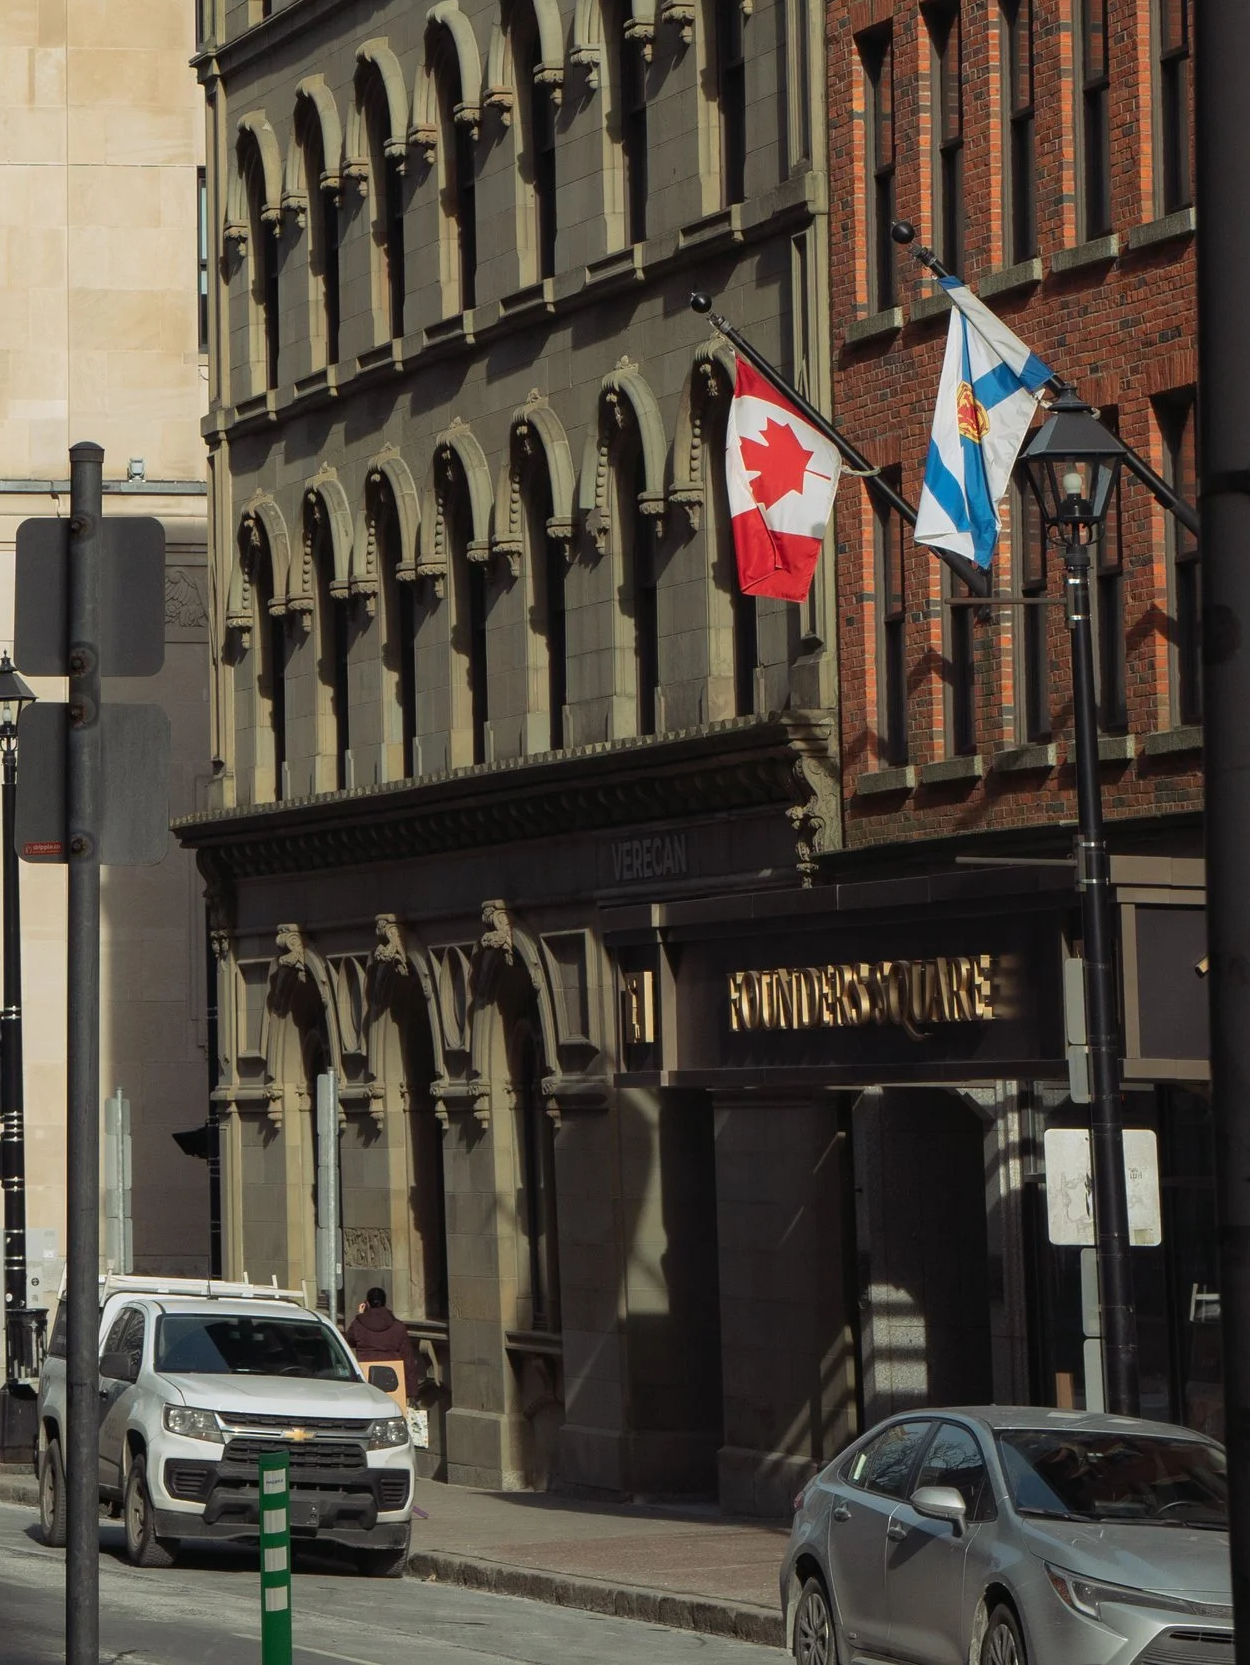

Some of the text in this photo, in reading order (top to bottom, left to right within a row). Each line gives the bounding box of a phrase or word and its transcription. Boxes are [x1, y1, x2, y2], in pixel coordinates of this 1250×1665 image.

[611, 834, 687, 881] VERECAN
[726, 955, 995, 1041] FOUNDERS SQUARE
